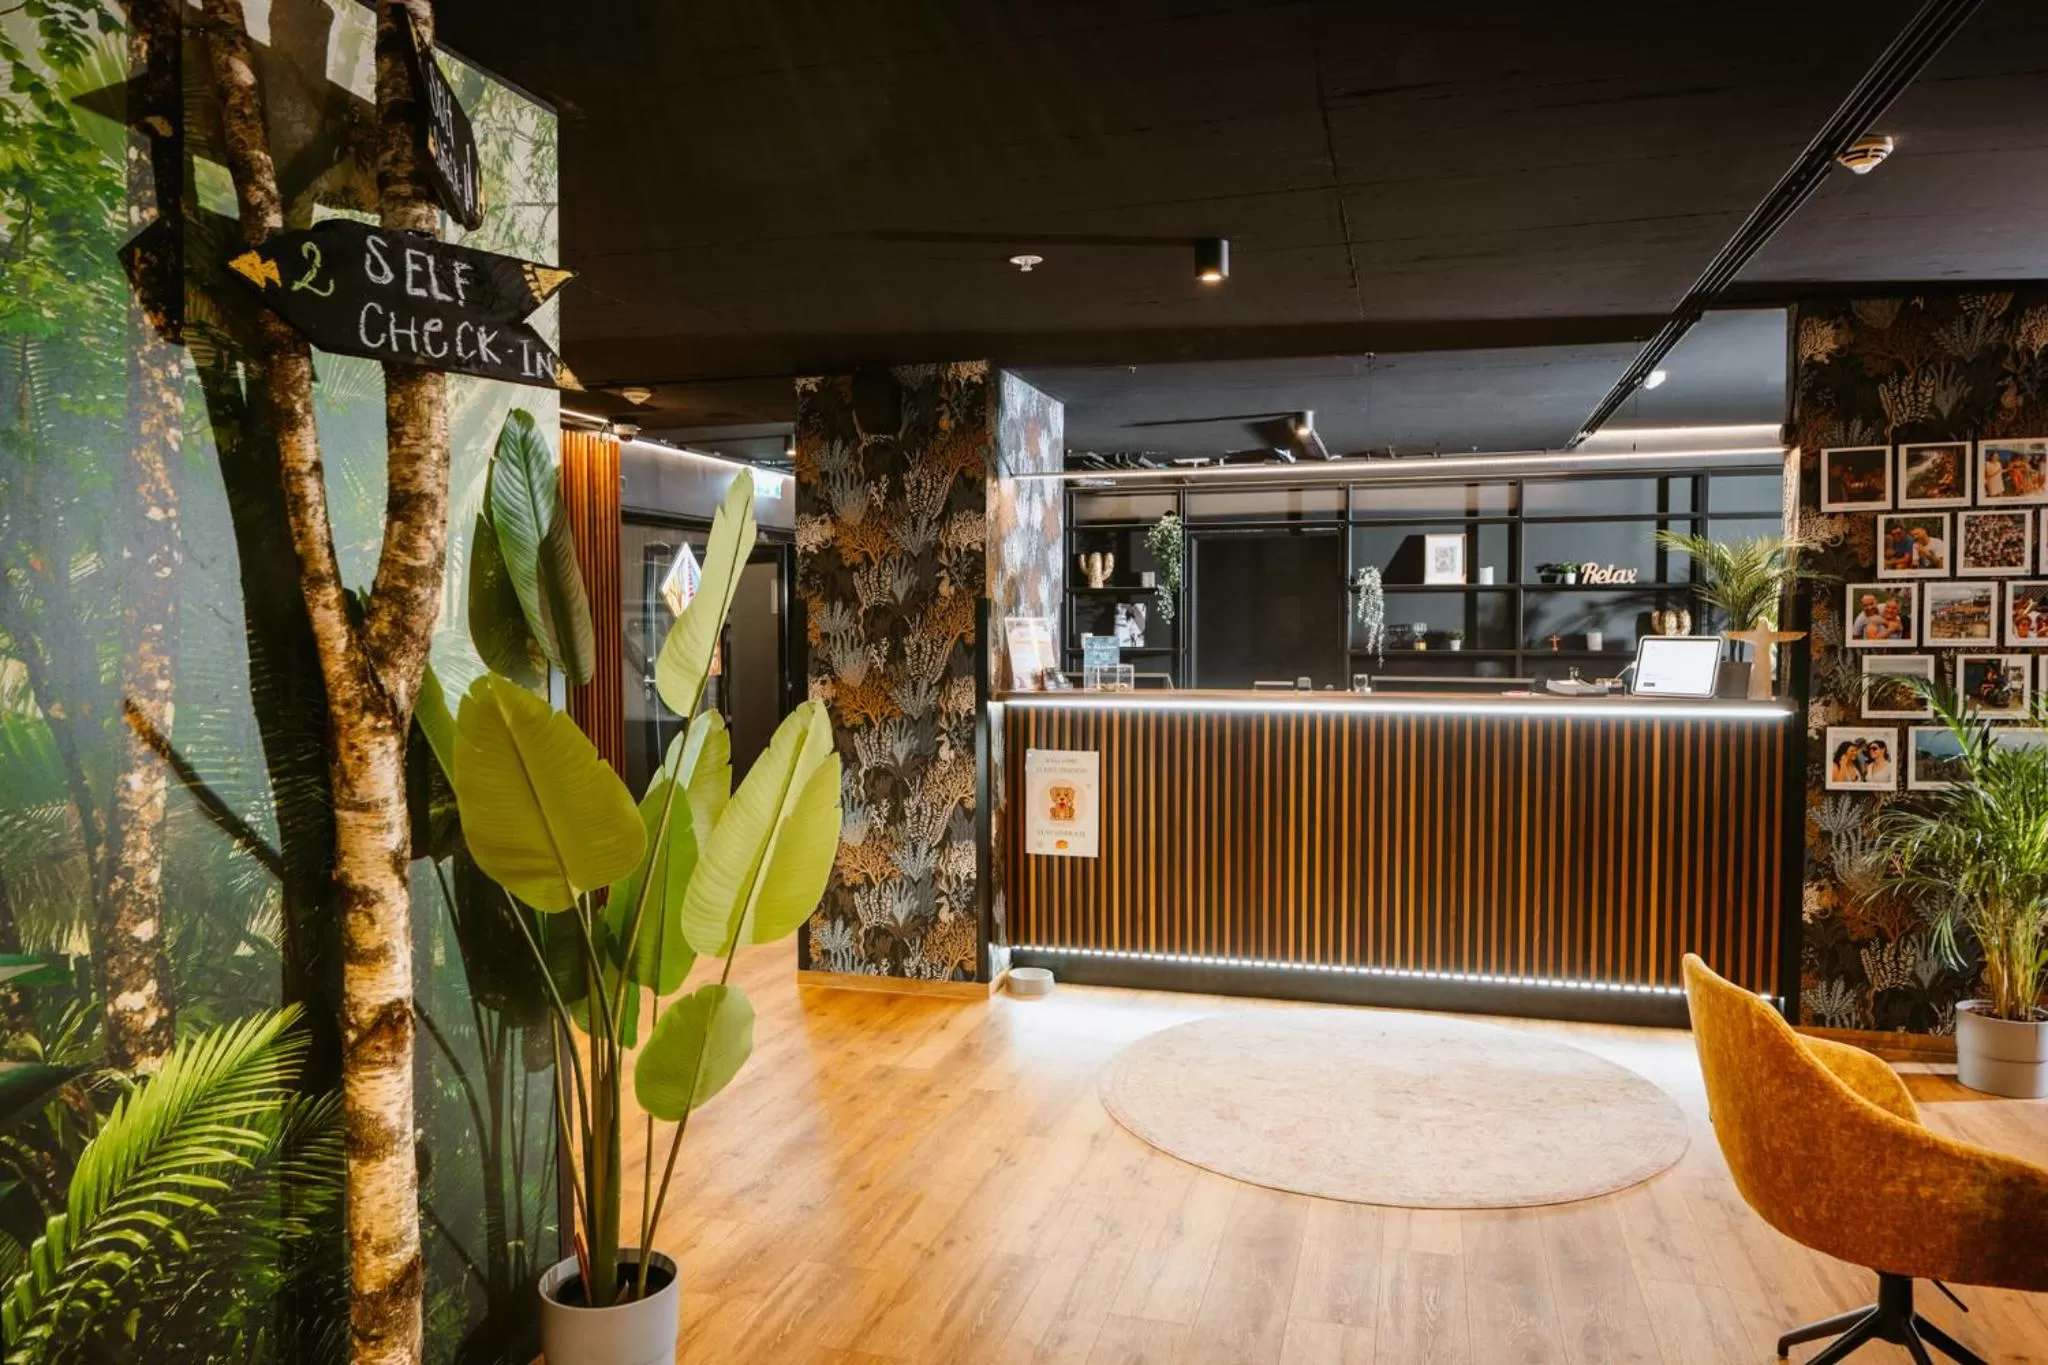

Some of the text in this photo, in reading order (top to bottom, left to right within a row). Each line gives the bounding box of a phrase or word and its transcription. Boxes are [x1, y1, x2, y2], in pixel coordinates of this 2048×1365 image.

[291, 235, 473, 307] 2 SELF
[1581, 561, 1638, 585] Relax
